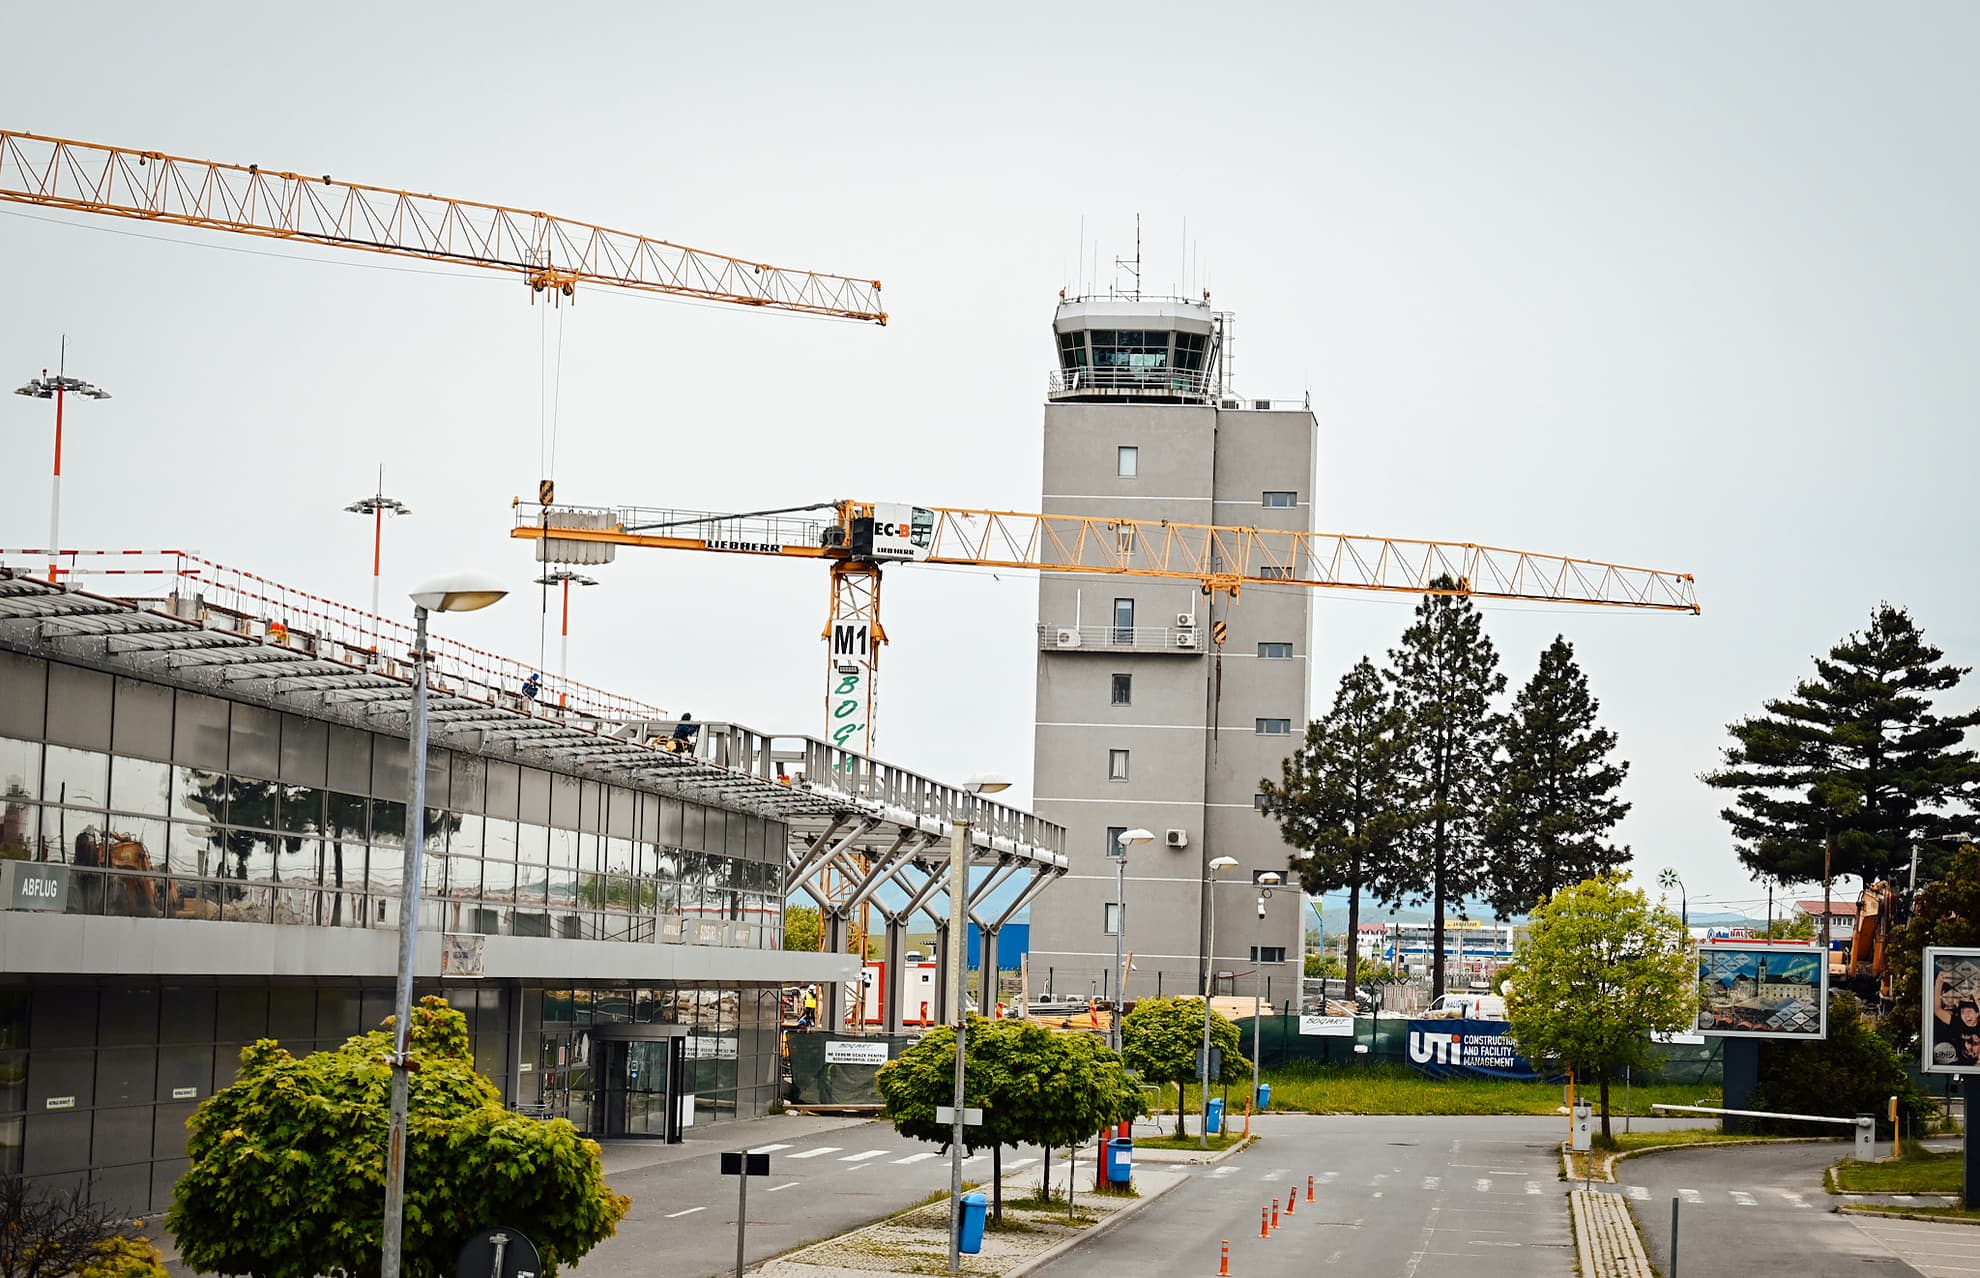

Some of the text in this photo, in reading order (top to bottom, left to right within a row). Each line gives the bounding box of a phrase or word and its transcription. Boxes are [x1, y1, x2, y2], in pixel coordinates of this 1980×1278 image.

[874, 523, 911, 538] EC-B
[707, 540, 781, 552] LIEBHERR
[834, 625, 867, 655] M1
[22, 877, 58, 898] ABFLUG
[1463, 1046, 1512, 1057] AND FACILITY
[1463, 1056, 1515, 1068] MANAGEMENT
